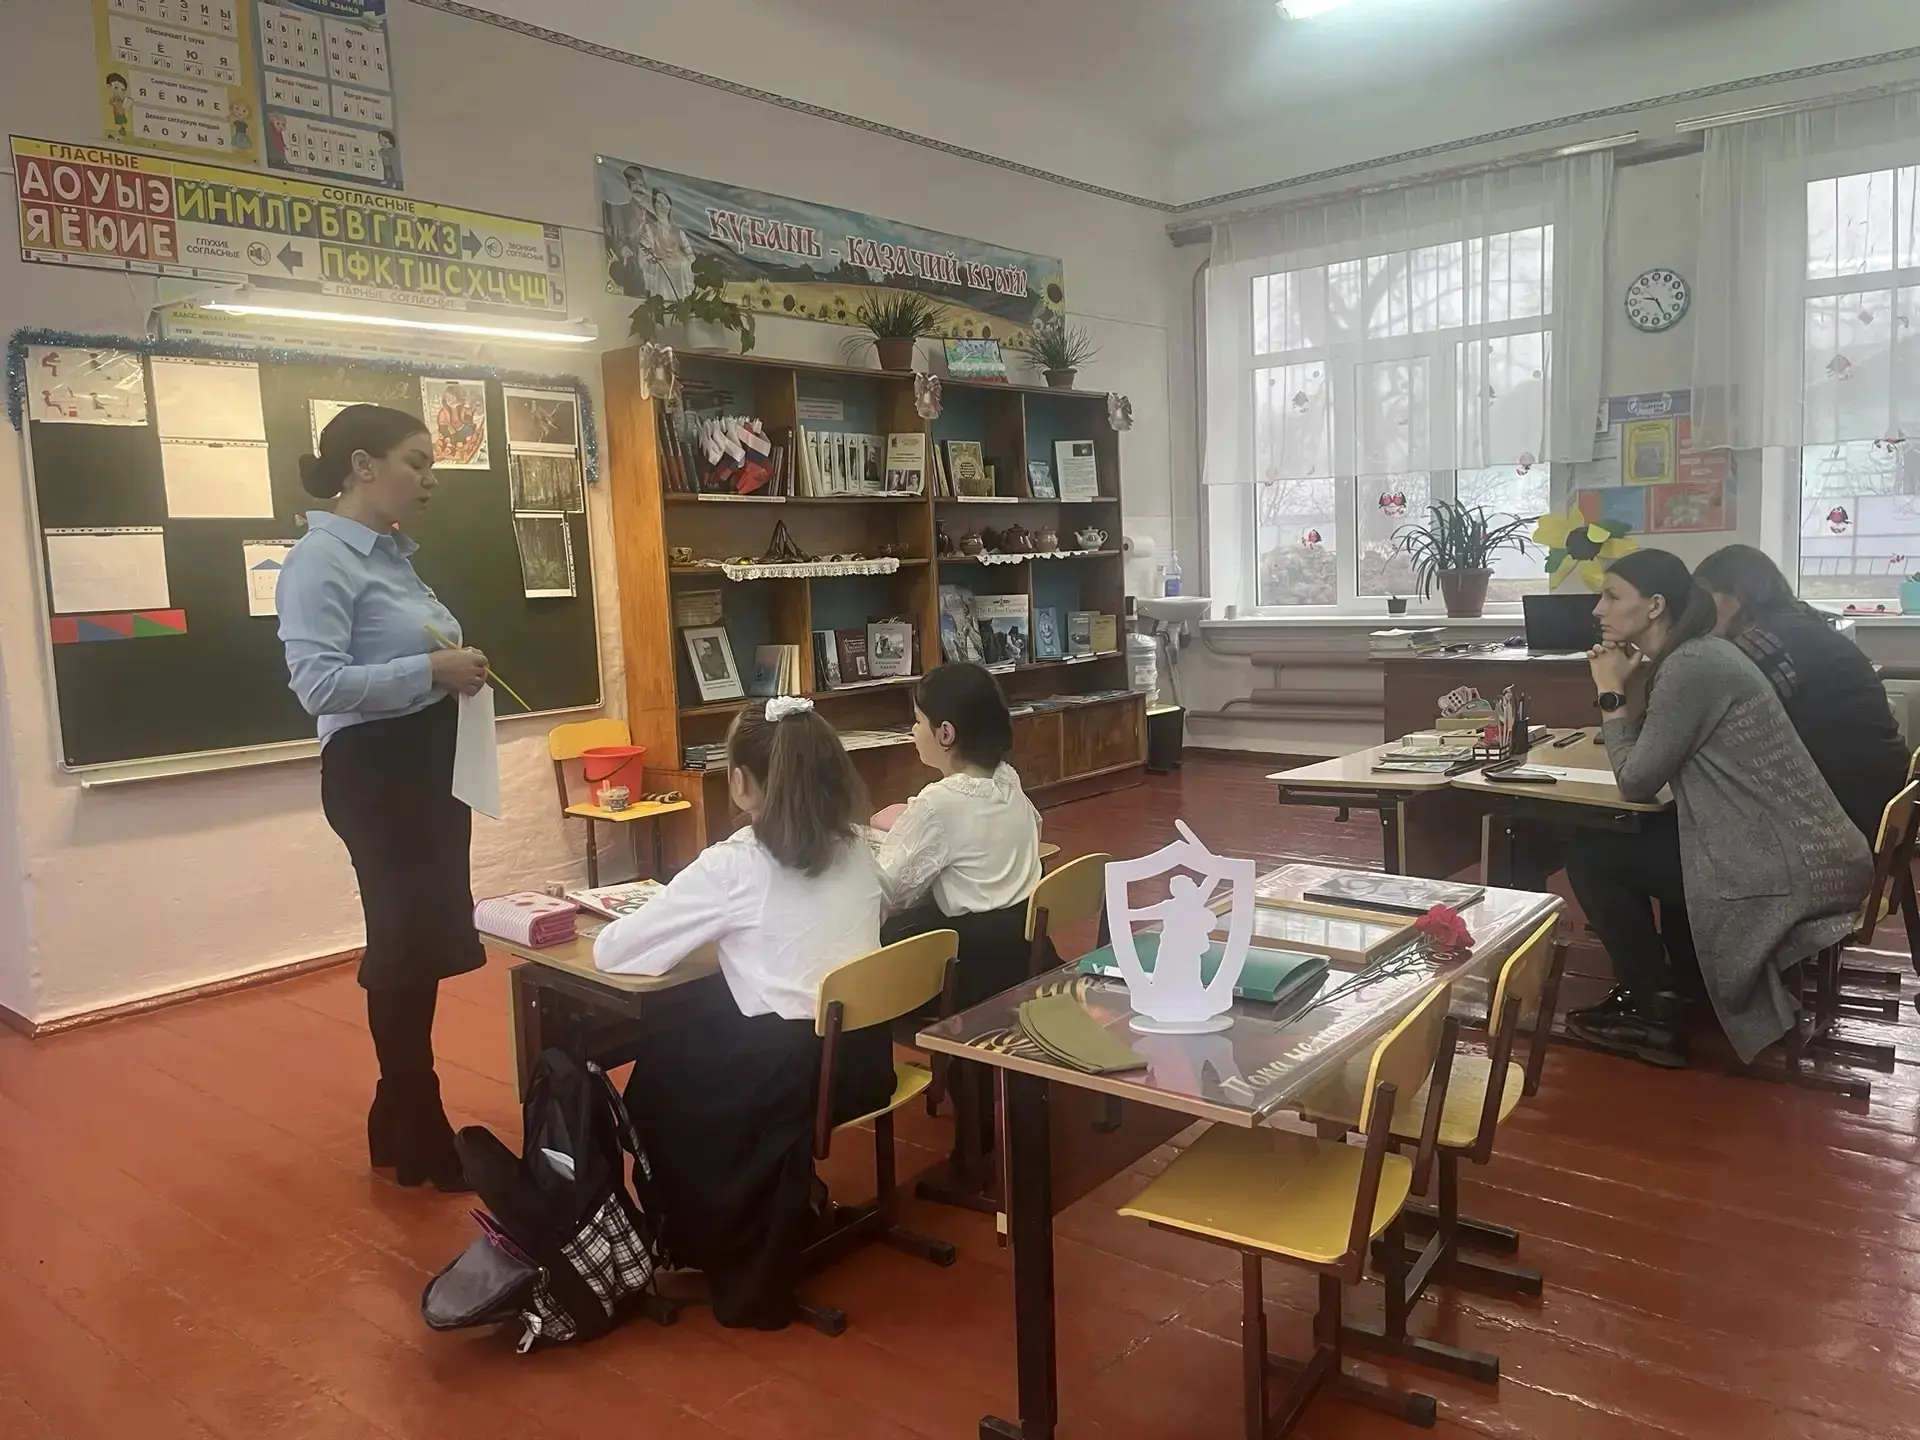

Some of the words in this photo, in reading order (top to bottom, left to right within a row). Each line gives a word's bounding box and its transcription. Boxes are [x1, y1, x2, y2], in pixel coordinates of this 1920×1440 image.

[50, 144, 139, 169] ГЛАСНЫЕ
[322, 188, 415, 213] СОГЛАСНЫЕ
[187, 245, 241, 259] СОГЛАСНЫЕ
[196, 237, 229, 248] ГЛУХИЕ
[706, 208, 822, 258] КУБАНЬ
[846, 236, 961, 286] КАЗАЧИЙ
[965, 262, 1028, 297] КРАЙ!
[336, 284, 384, 300] ПАРНЫЕ
[390, 291, 459, 308] СОГЛАСНЫЕ
